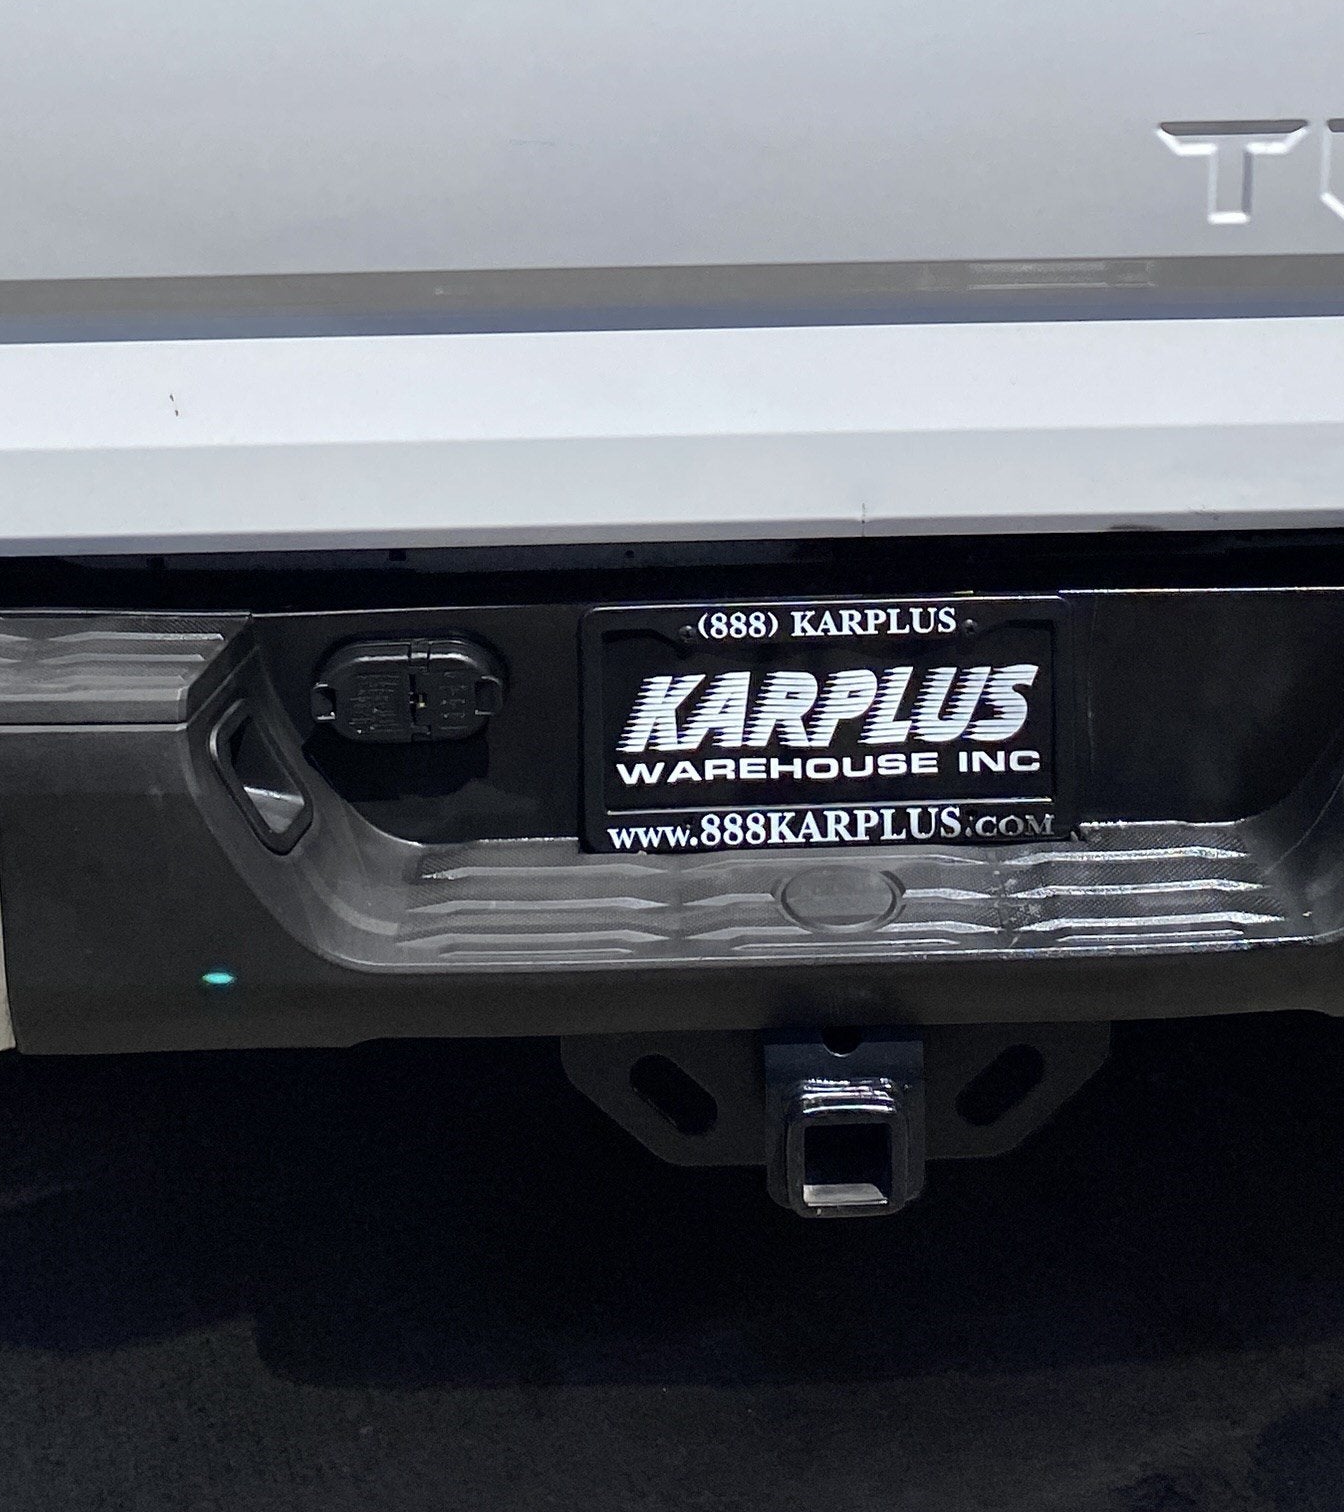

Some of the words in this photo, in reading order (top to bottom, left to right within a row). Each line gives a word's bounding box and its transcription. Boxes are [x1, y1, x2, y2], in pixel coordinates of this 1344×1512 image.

[696, 611, 779, 640] (888)
[790, 607, 957, 637] KARPLUS
[615, 663, 1039, 754] KARPLUS
[615, 752, 939, 785] WAREHOUSE
[958, 749, 1041, 774] INC
